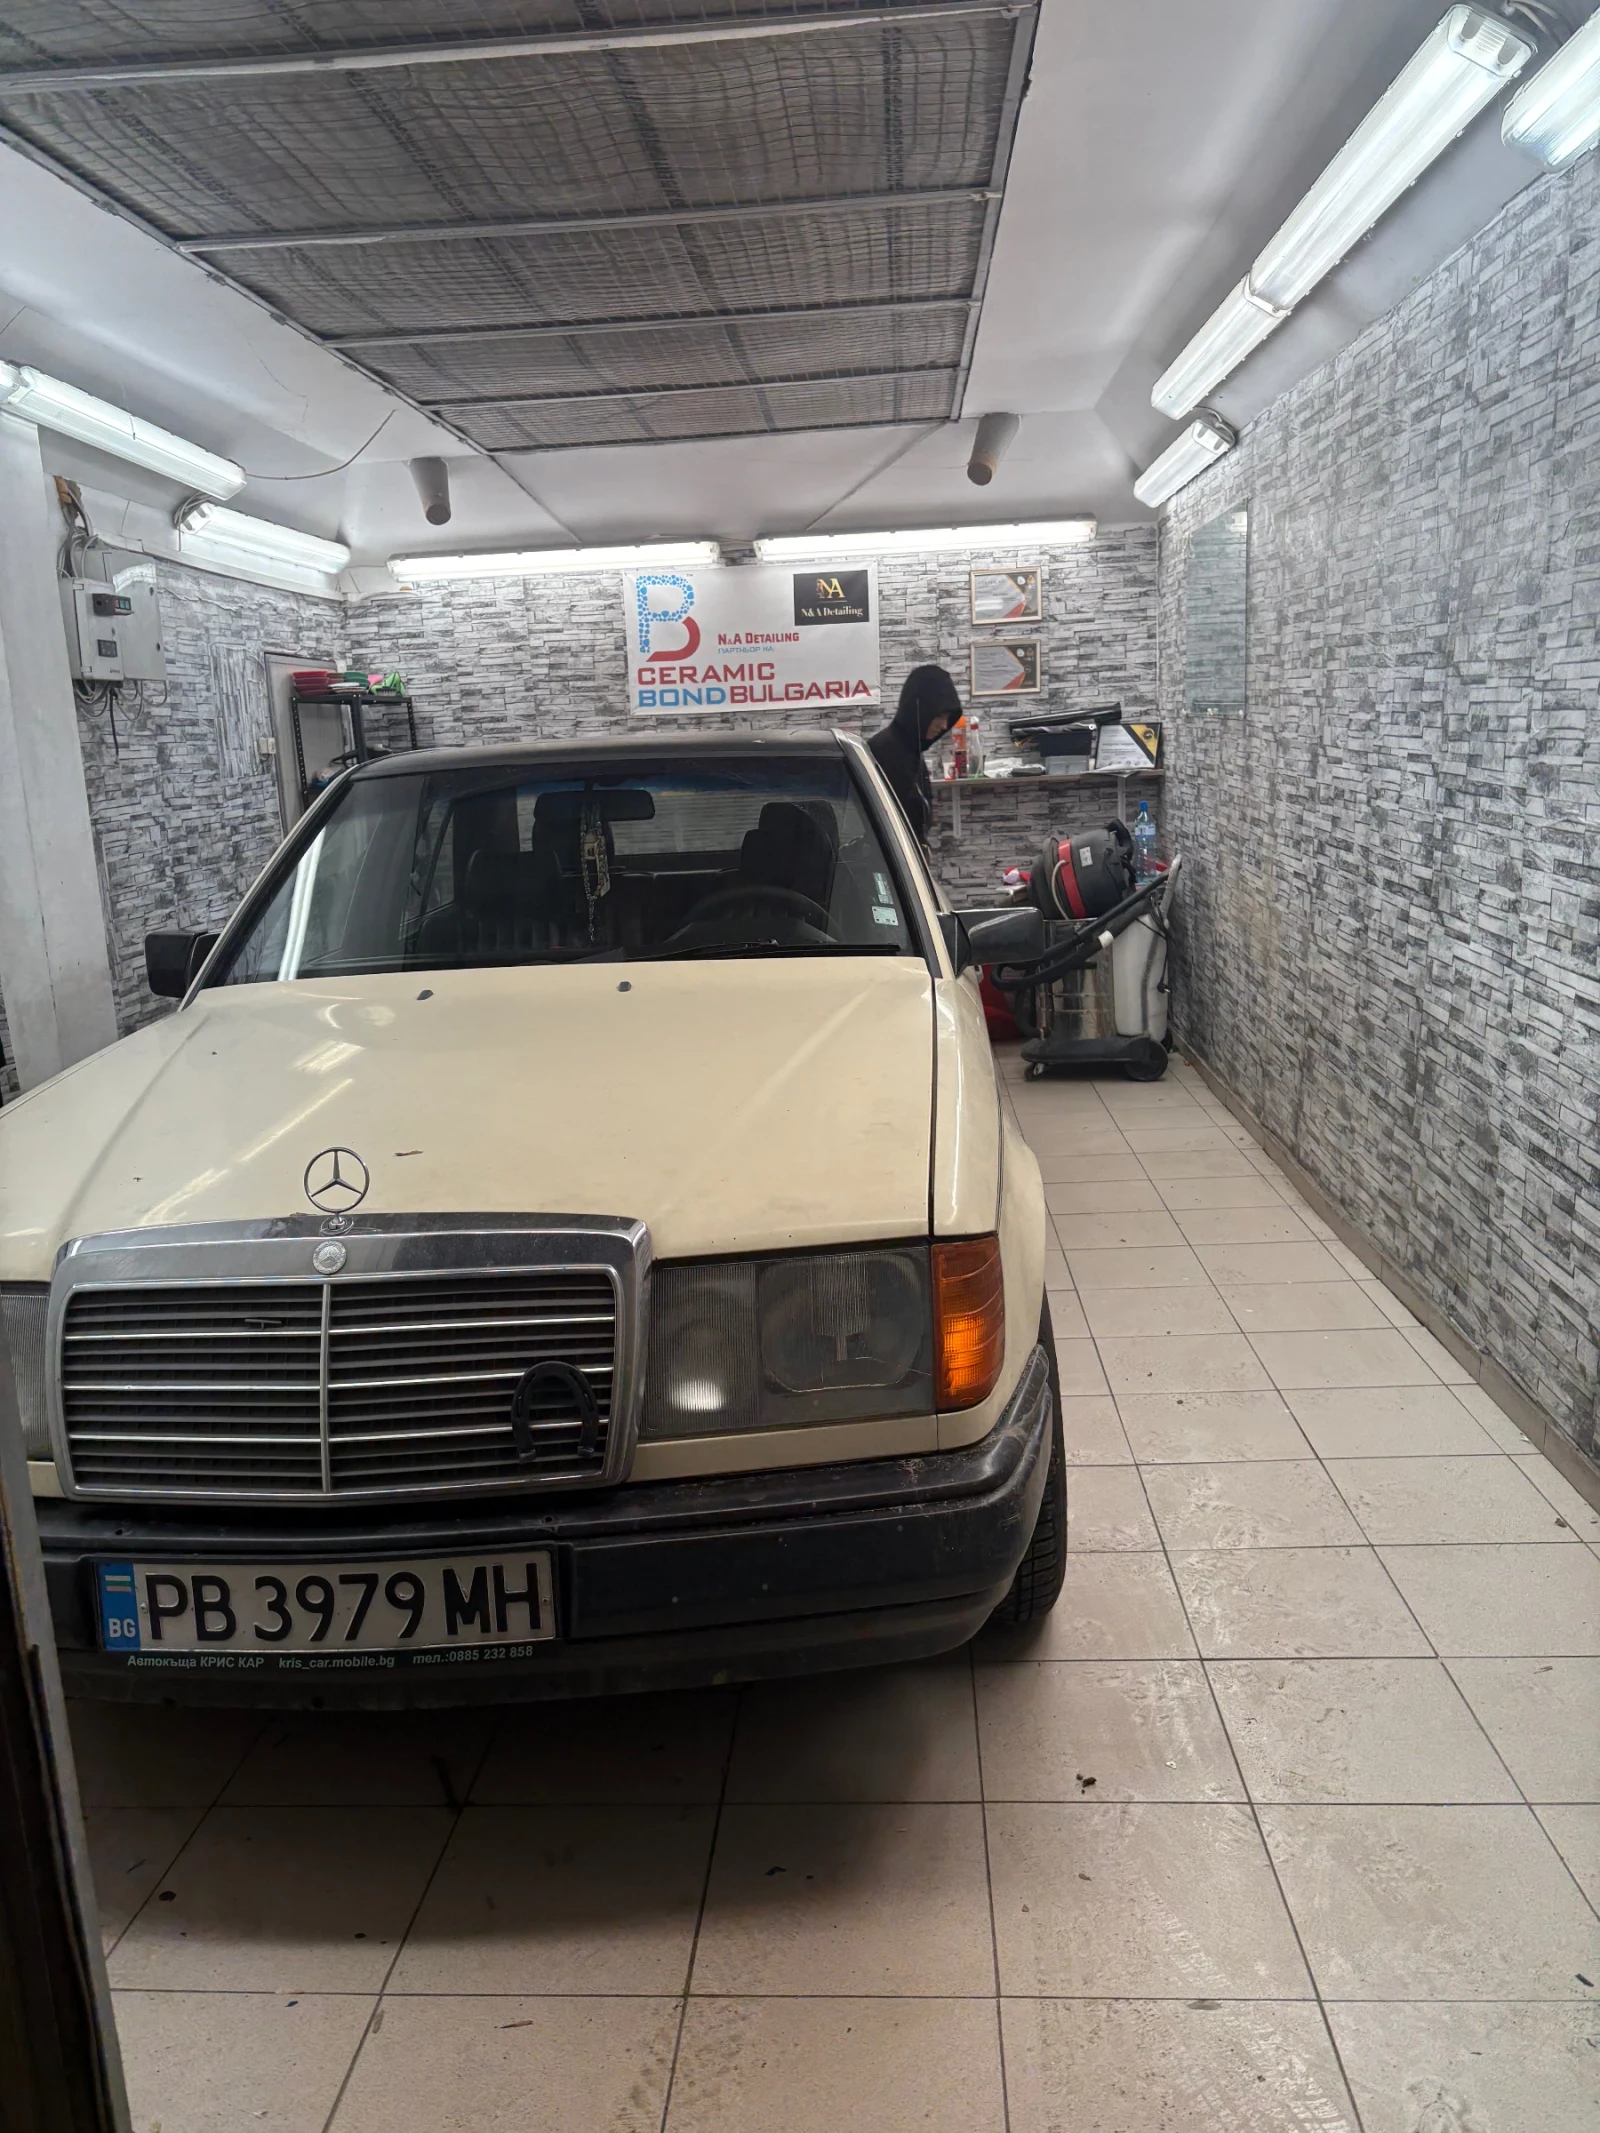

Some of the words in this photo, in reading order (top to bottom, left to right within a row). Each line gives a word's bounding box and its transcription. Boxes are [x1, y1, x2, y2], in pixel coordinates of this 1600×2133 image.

[823, 605, 863, 618] Detailing
[717, 633, 743, 646] N&A
[637, 662, 775, 686] CERAMIC
[253, 1571, 425, 1642] 3979
[108, 1618, 136, 1639] BG
[484, 1647, 506, 1660] 232
[510, 1645, 533, 1658] 858
[200, 1656, 235, 1669] КРИС
[238, 1656, 265, 1668] КАР
[279, 1654, 395, 1670] kris_car.mobile.bg
